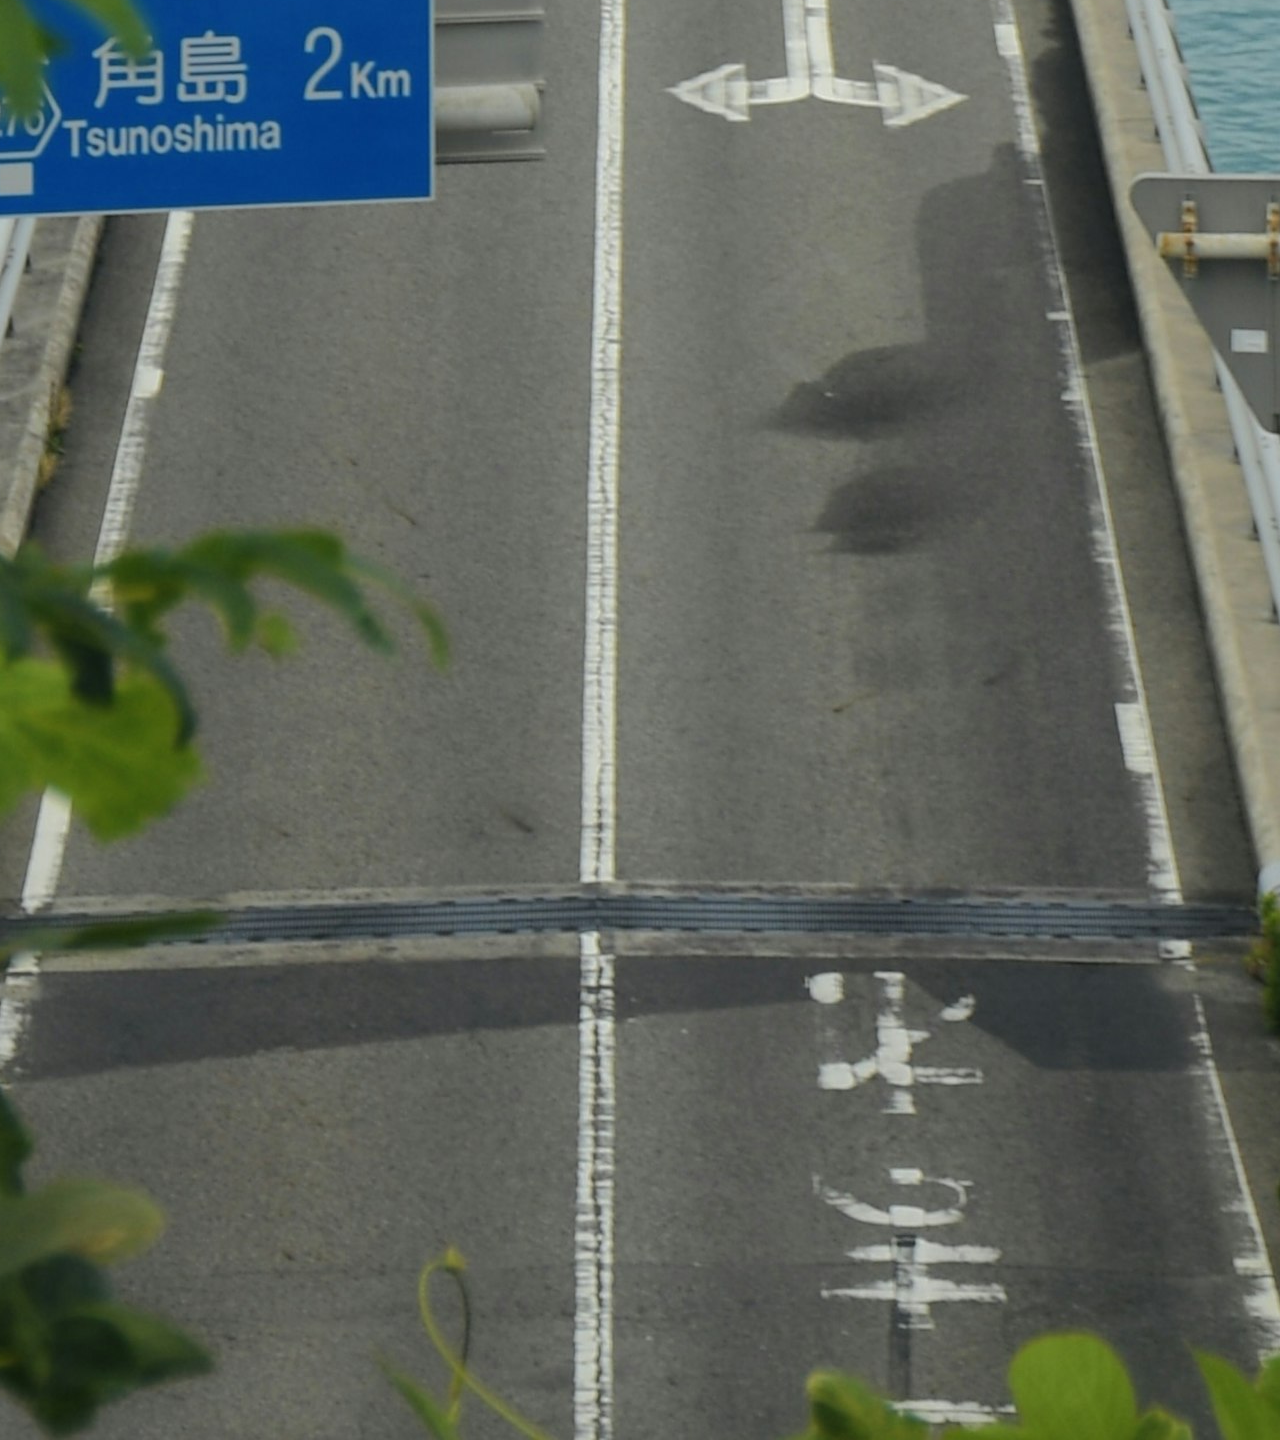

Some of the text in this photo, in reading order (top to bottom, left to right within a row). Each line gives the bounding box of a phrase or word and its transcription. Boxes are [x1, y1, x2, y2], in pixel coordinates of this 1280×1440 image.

[92, 30, 248, 108] 角島
[62, 113, 282, 158] Tsunoshima
[804, 970, 1016, 1423] まれ
